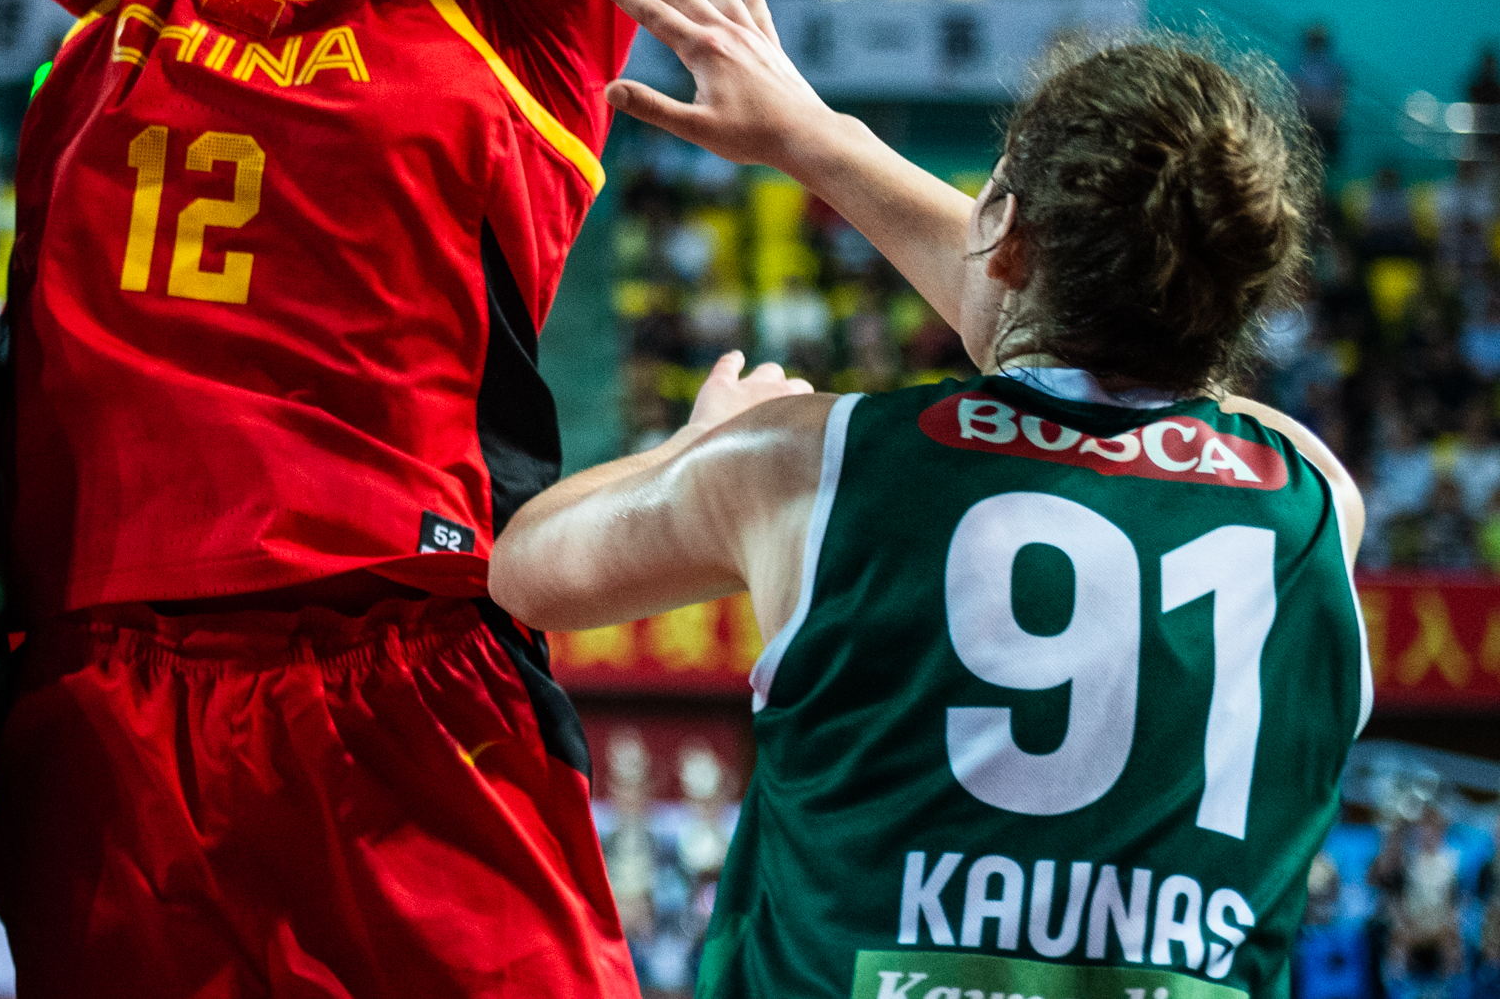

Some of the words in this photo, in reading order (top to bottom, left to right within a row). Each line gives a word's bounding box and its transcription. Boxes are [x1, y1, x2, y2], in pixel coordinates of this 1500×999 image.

[112, 3, 371, 88] CHINA
[120, 126, 266, 305] 12
[957, 398, 1263, 483] BOSCA
[433, 524, 462, 553] 52
[945, 491, 1277, 840] 91
[897, 851, 1255, 980] KAUNAS
